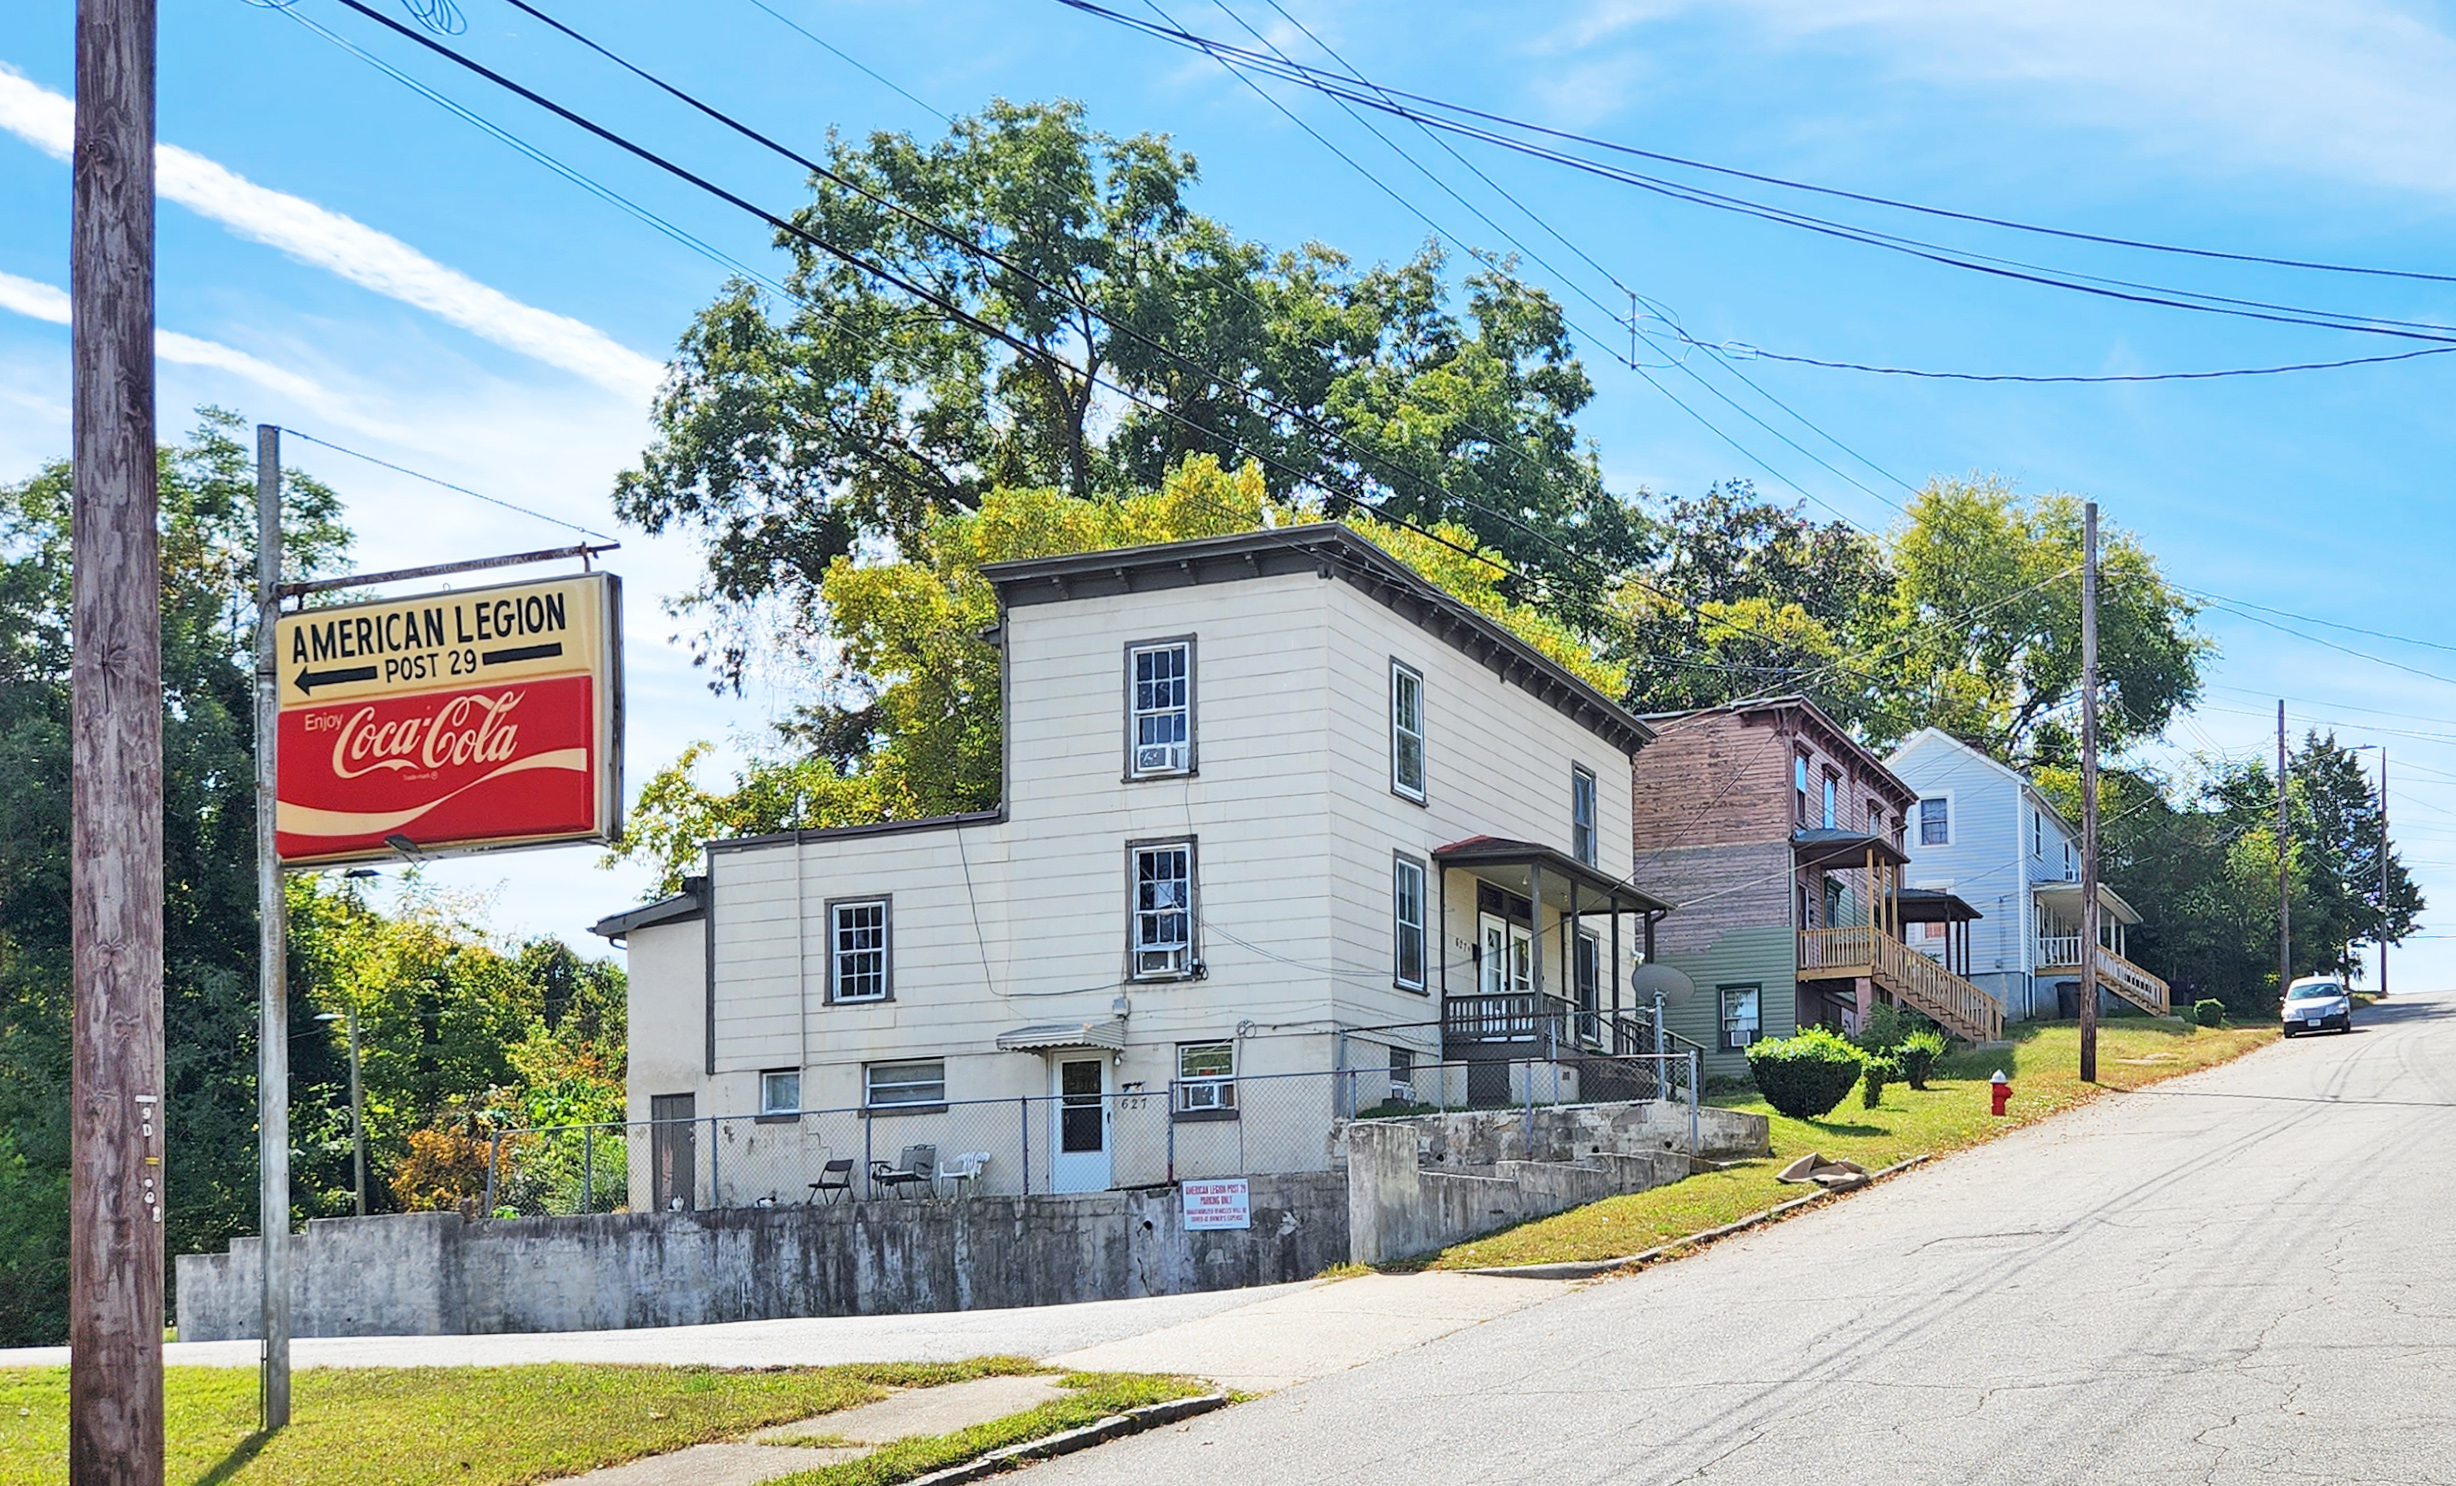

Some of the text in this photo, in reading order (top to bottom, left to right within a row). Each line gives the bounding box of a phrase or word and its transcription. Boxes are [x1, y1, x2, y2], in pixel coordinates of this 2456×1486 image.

[292, 592, 566, 664] AMERICAN LEGION
[385, 650, 477, 683] POST 29
[304, 713, 344, 732] Enjoy
[1121, 1097, 1147, 1110] 627
